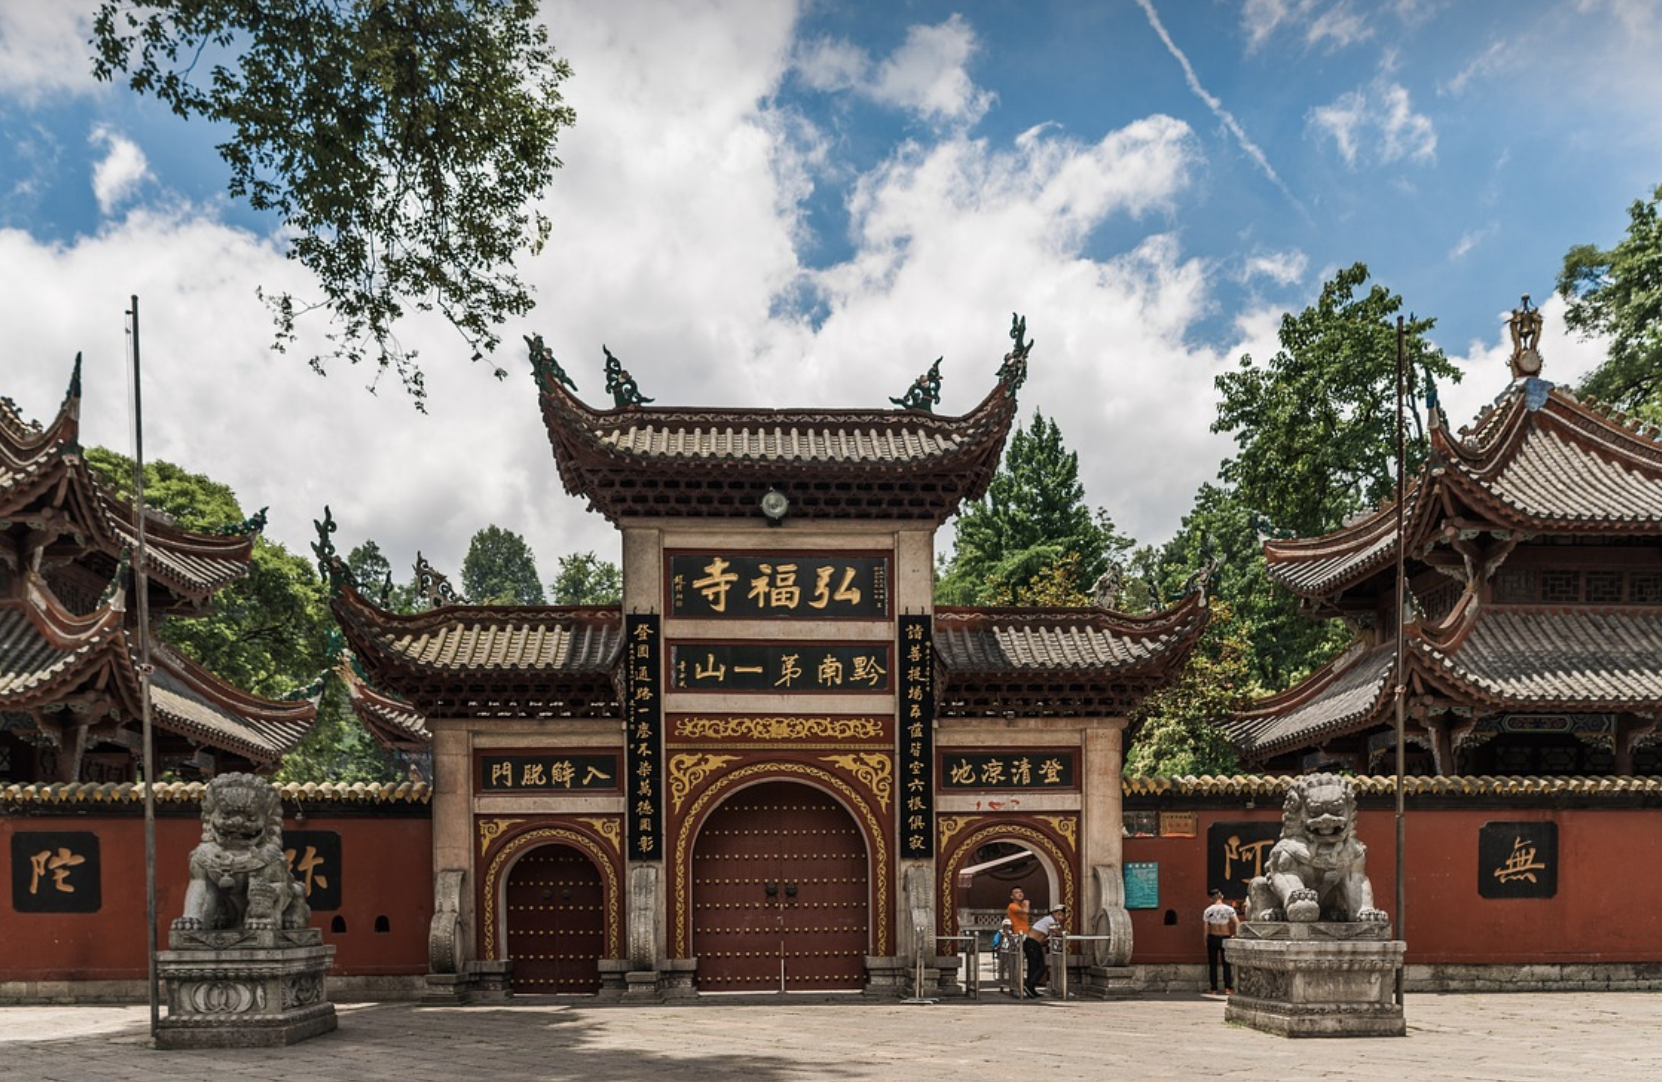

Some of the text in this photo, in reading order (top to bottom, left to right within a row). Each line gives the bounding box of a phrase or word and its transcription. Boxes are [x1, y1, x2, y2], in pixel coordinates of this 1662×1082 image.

[692, 557, 861, 612] 弘福寺
[30, 847, 85, 894] 陀
[1225, 835, 1275, 884] 阿
[1494, 836, 1545, 883] 無
